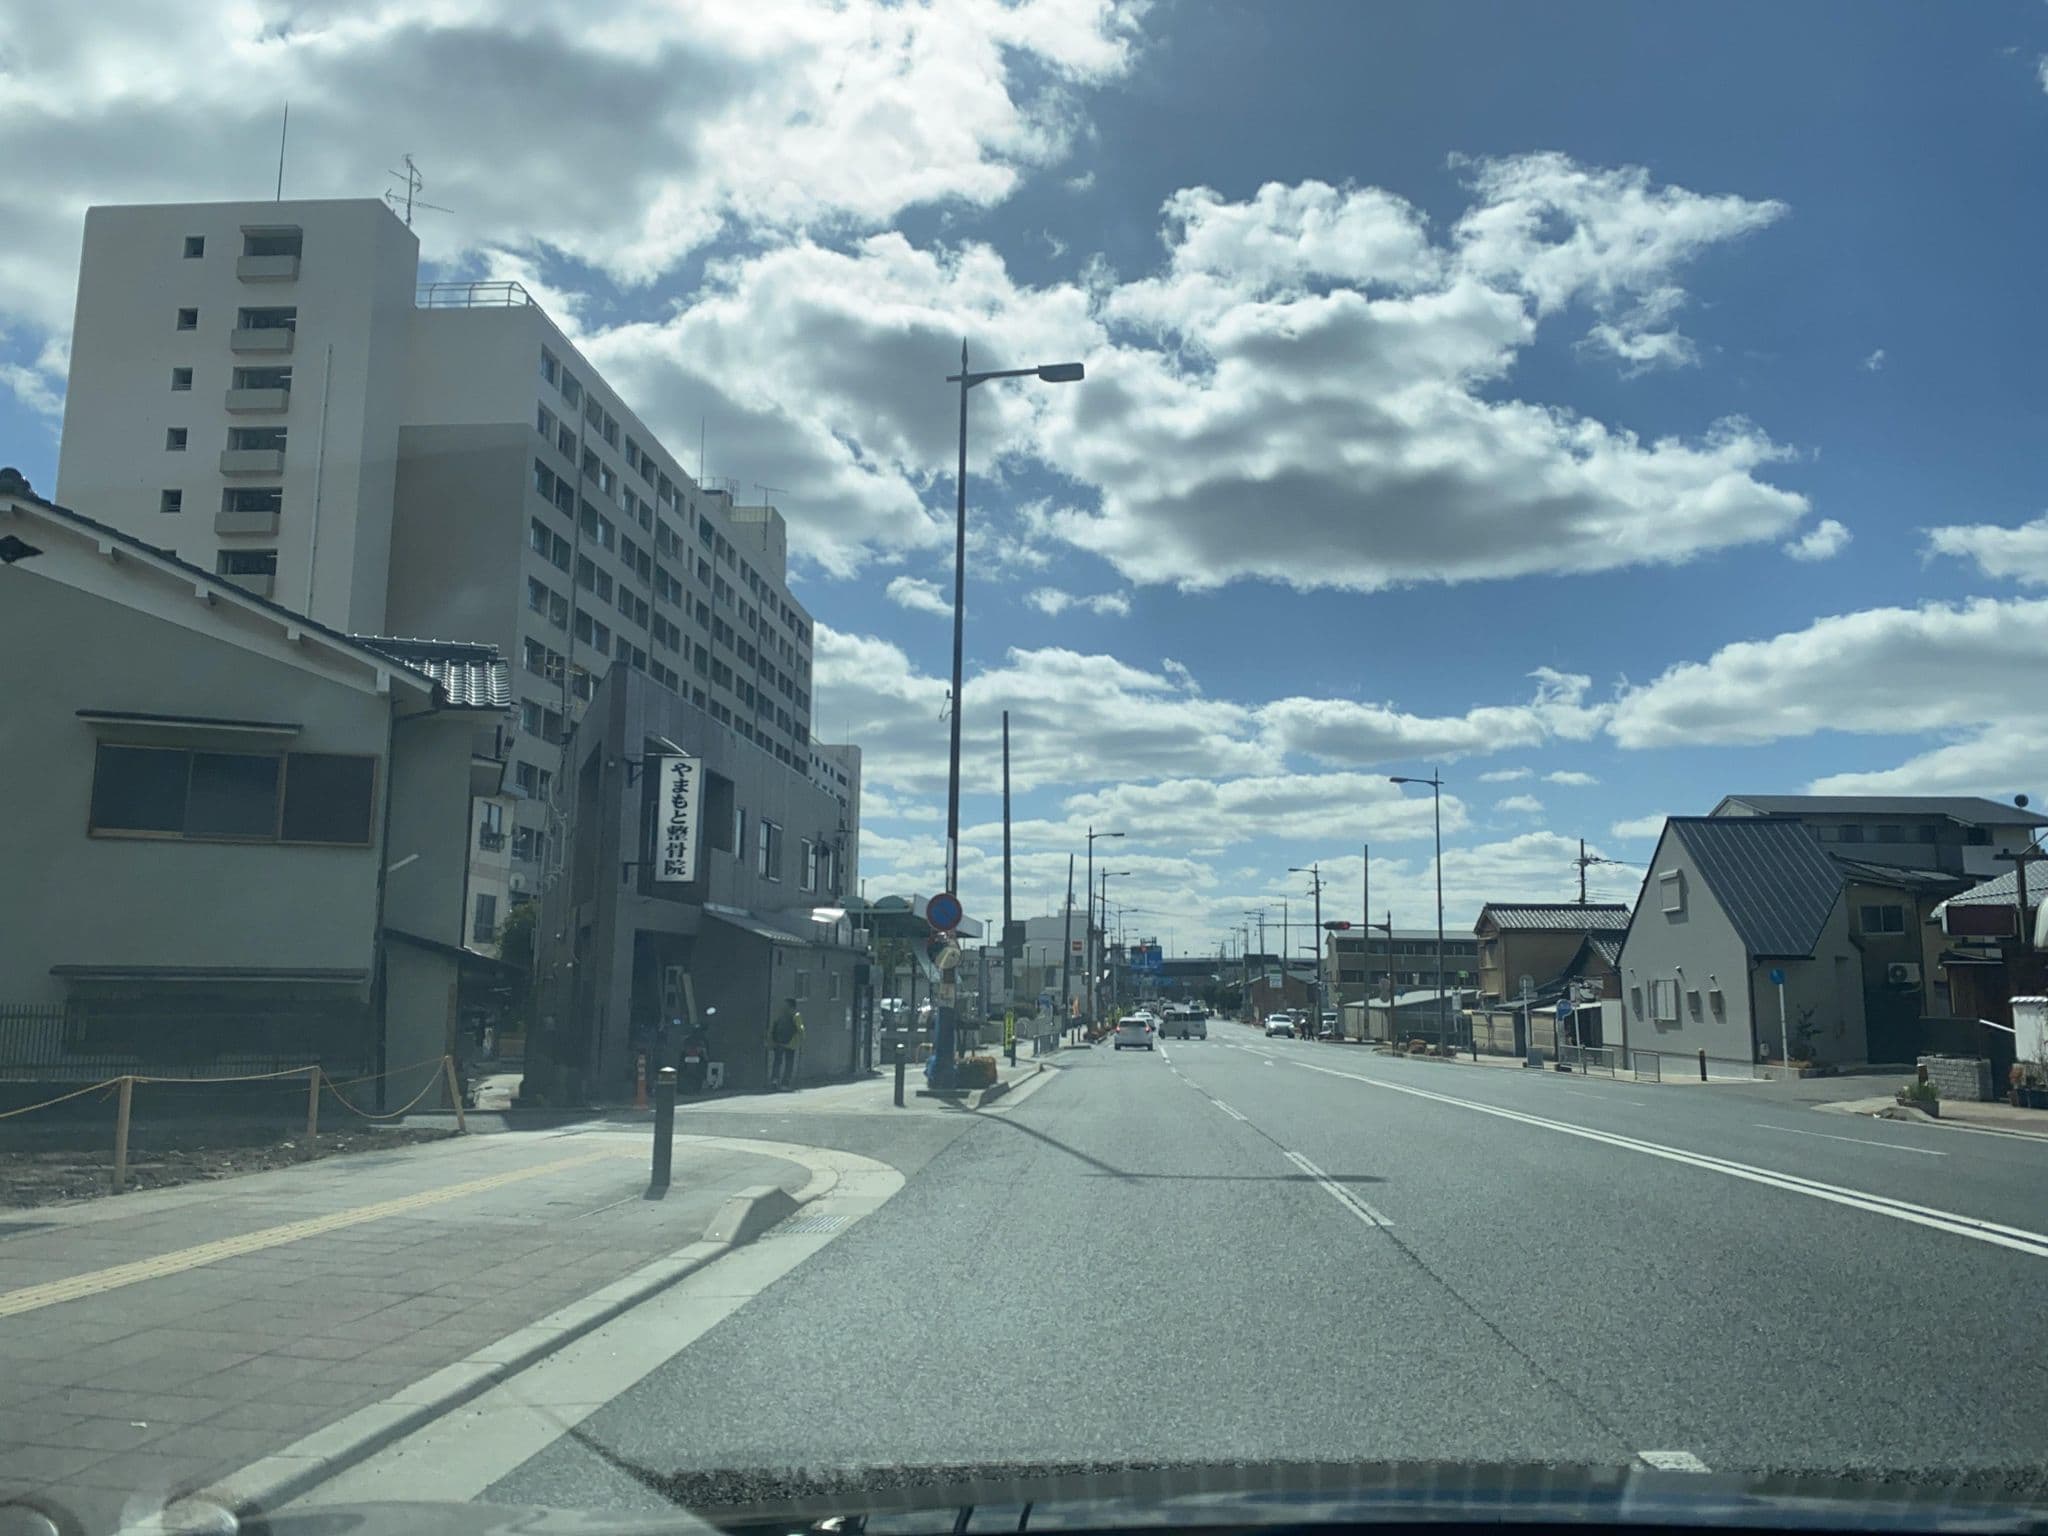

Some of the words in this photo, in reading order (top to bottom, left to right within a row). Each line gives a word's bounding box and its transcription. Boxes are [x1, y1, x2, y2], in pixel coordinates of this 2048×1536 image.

[664, 763, 692, 875] やまもと整骨院
